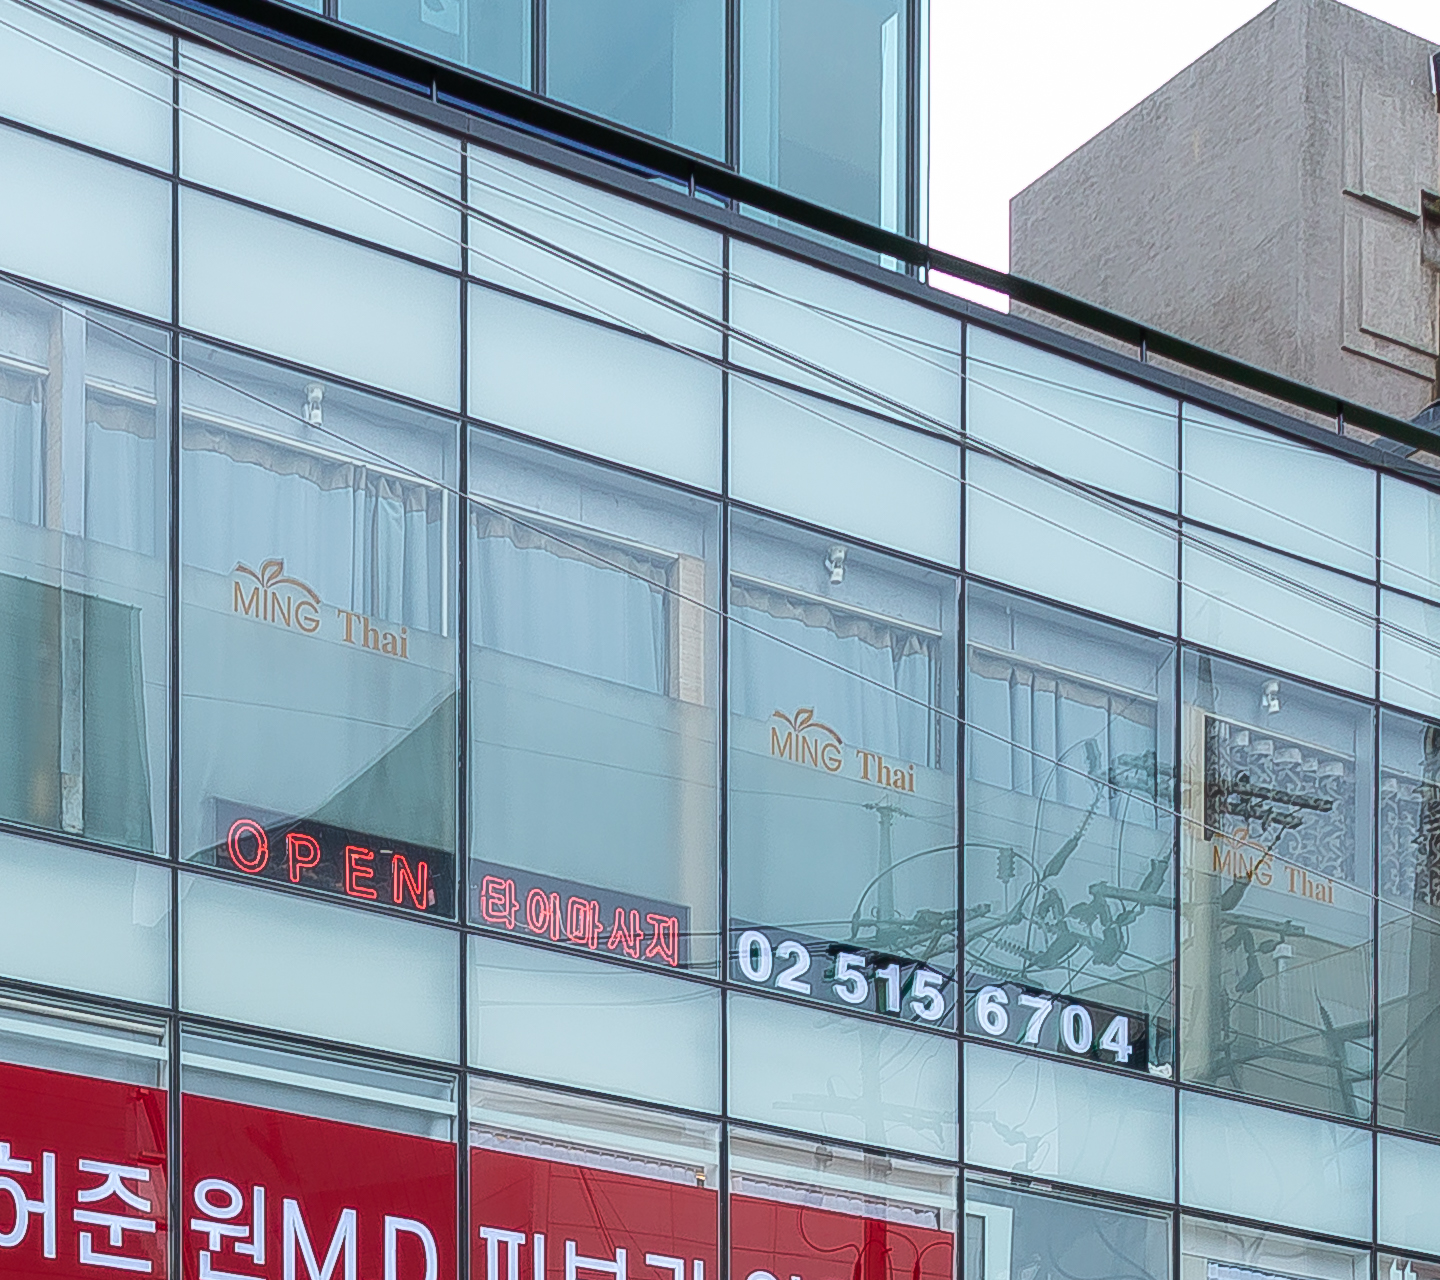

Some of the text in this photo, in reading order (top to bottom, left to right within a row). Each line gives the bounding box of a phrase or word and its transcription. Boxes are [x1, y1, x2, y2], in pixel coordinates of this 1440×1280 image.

[233, 579, 410, 660] MING Thai
[771, 724, 916, 794] MING Thai
[226, 816, 680, 967] OPEN 타이마사지
[1212, 845, 1334, 904] MING Thai
[737, 929, 1133, 1064] 02 515 6704
